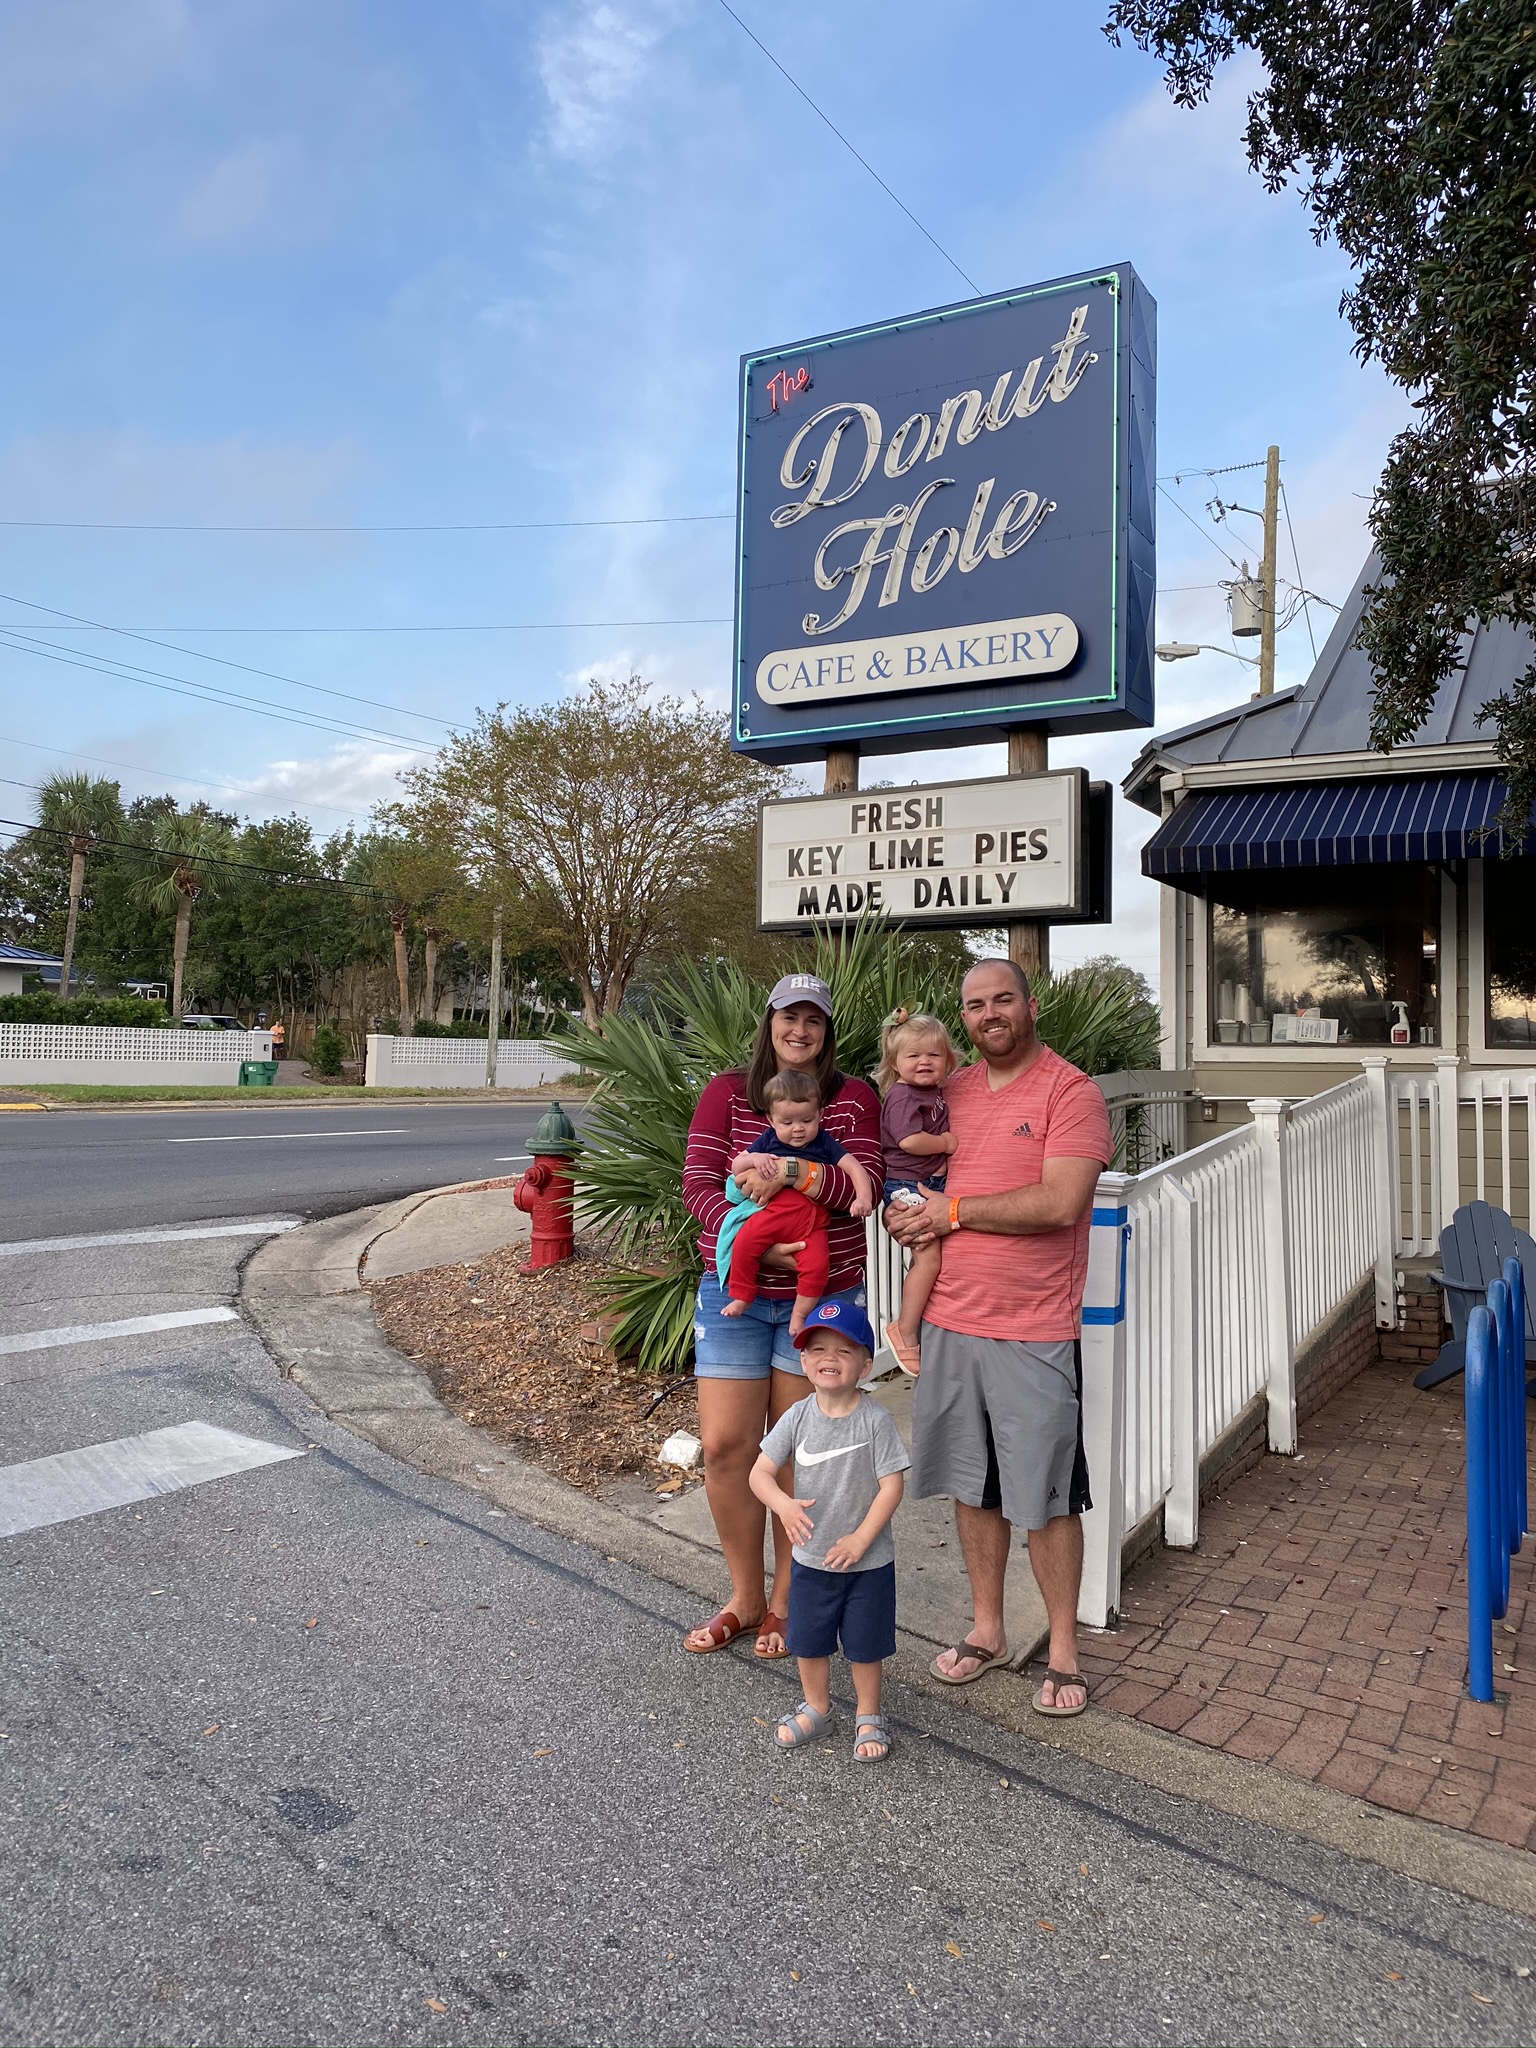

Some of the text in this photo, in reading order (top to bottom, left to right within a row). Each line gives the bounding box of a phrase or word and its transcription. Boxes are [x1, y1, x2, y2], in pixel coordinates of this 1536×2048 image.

[766, 366, 810, 411] The
[770, 304, 1098, 529] Donut
[802, 478, 1057, 635] Hole
[767, 626, 1065, 692] CAFE & BAKERY
[851, 796, 944, 834] FRESH
[788, 828, 1048, 878] KEY LIME PIES
[797, 872, 1017, 916] MADE DAILY
